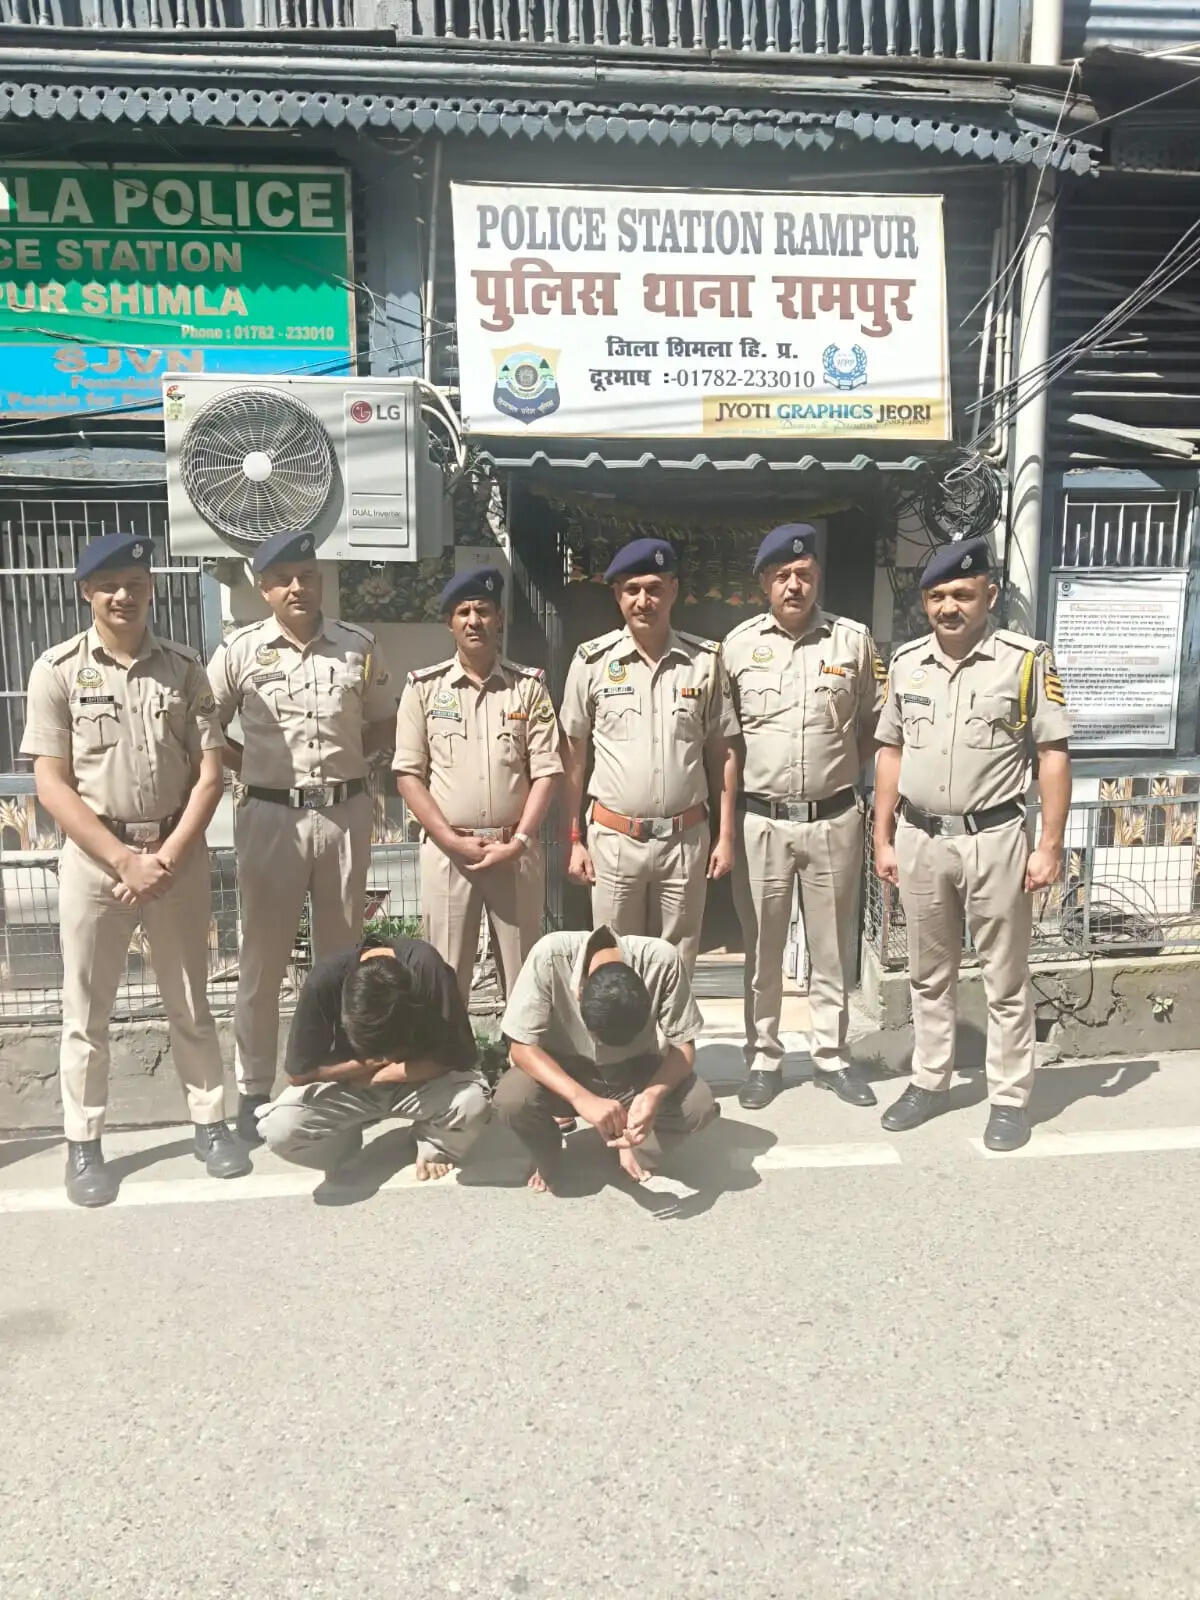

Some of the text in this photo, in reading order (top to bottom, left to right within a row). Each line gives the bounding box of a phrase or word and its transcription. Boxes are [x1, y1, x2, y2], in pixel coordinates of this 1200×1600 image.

[113, 178, 335, 228] POLICE
[476, 204, 919, 259] POLICE STATION RAMPUR
[56, 239, 243, 272] STATION
[0, 281, 248, 316] UR SHIMLA
[470, 257, 917, 338] पुलिस थाना रामपुर
[181, 324, 222, 339] Phone
[234, 325, 275, 340] 01782
[285, 326, 335, 341] 233010
[54, 345, 204, 373] SJVN
[606, 336, 799, 359] जिला शिमला हि. प्र.
[589, 368, 652, 391] दूरभाष
[376, 404, 401, 420] LG
[716, 402, 770, 422] JYOTI
[776, 403, 873, 419] GRAPHICS
[876, 405, 932, 423] JEORI
